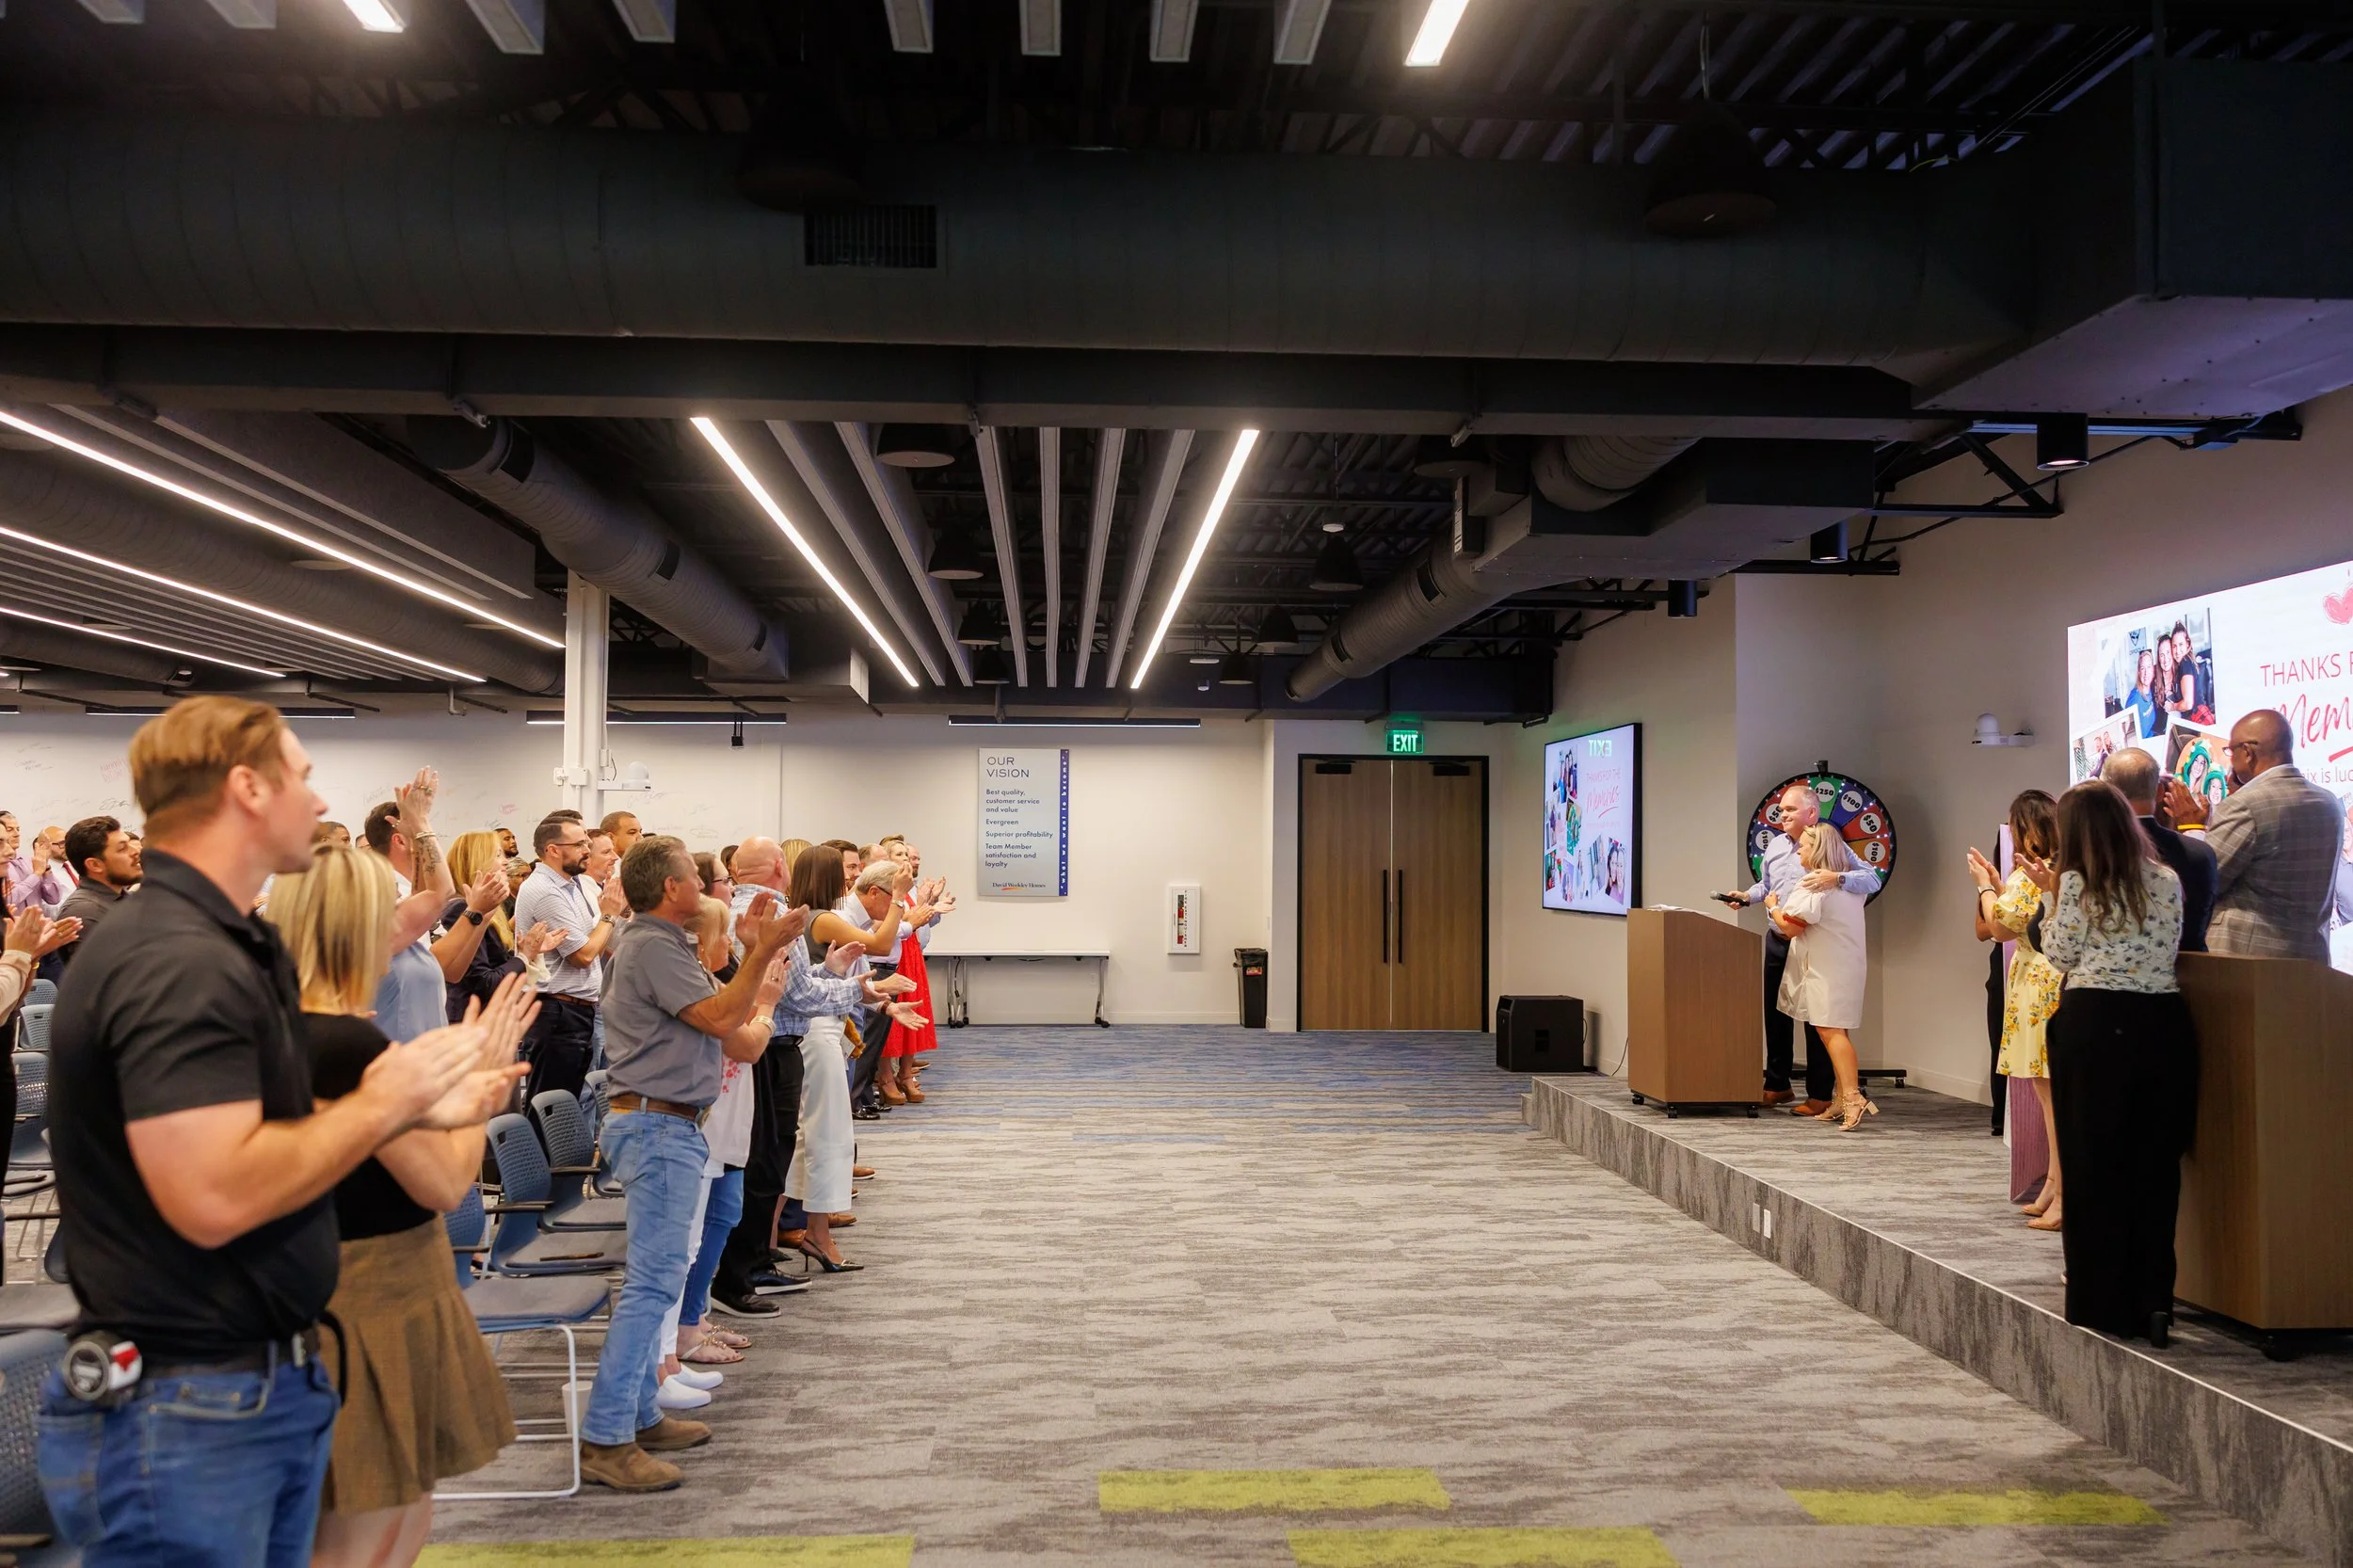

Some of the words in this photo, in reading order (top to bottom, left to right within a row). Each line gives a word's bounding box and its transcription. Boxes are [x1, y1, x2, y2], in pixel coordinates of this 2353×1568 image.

[2260, 652, 2342, 688] THANKS
[2272, 693, 2353, 749] Mem
[1394, 734, 1417, 752] EXIT
[986, 756, 1015, 766] OUR
[986, 768, 1030, 778] VISION
[2321, 767, 2331, 784] is
[1001, 789, 1025, 797] quality,
[1815, 788, 1834, 796] $250
[1062, 801, 1066, 811] to
[1843, 793, 1861, 808] $100
[1864, 814, 1878, 833] $50
[1062, 843, 1066, 856] we
[1870, 842, 1880, 863] $100
